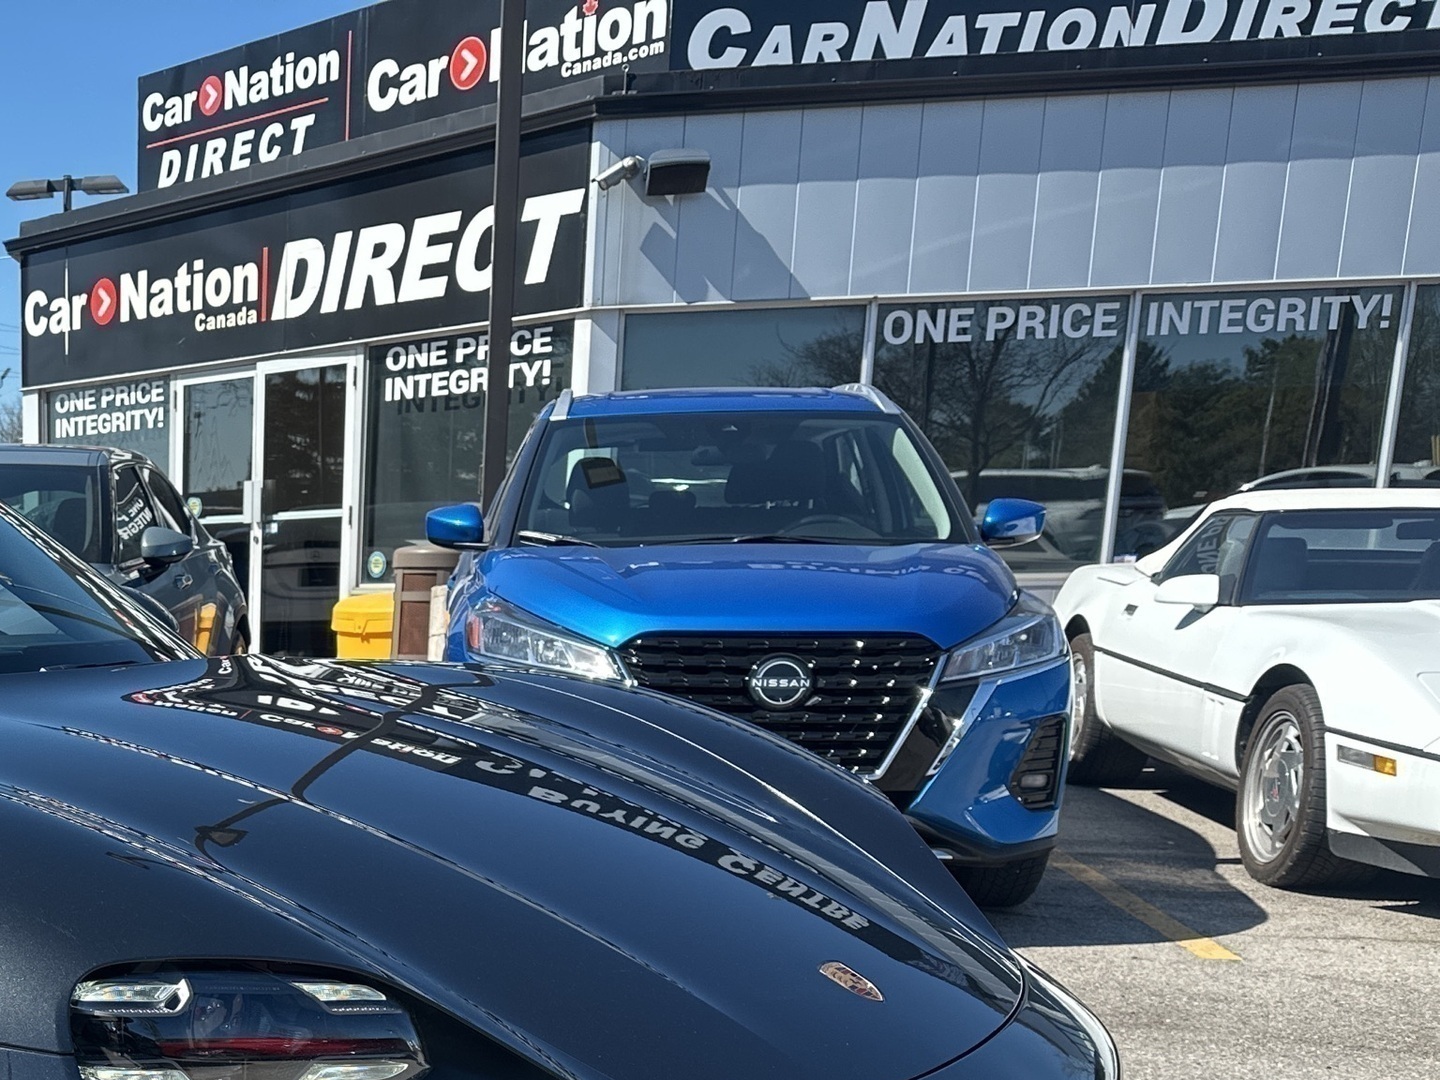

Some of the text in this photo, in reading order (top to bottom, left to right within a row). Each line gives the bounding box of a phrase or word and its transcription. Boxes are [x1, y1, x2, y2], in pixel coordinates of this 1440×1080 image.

[561, 40, 665, 78] Canada.com
[142, 50, 340, 132] Car Nation
[367, 53, 449, 112] Car
[157, 113, 316, 189] DIRECT
[24, 290, 88, 338] Car
[120, 259, 259, 322] Nation
[195, 307, 257, 333] Canada
[882, 294, 1392, 345] ONE PRICE INTEGRITY!
[386, 340, 449, 372] ONE
[55, 381, 165, 414] ONE PRICE
[55, 407, 165, 438] INTEGRITY!
[752, 678, 810, 688] NISSAN
